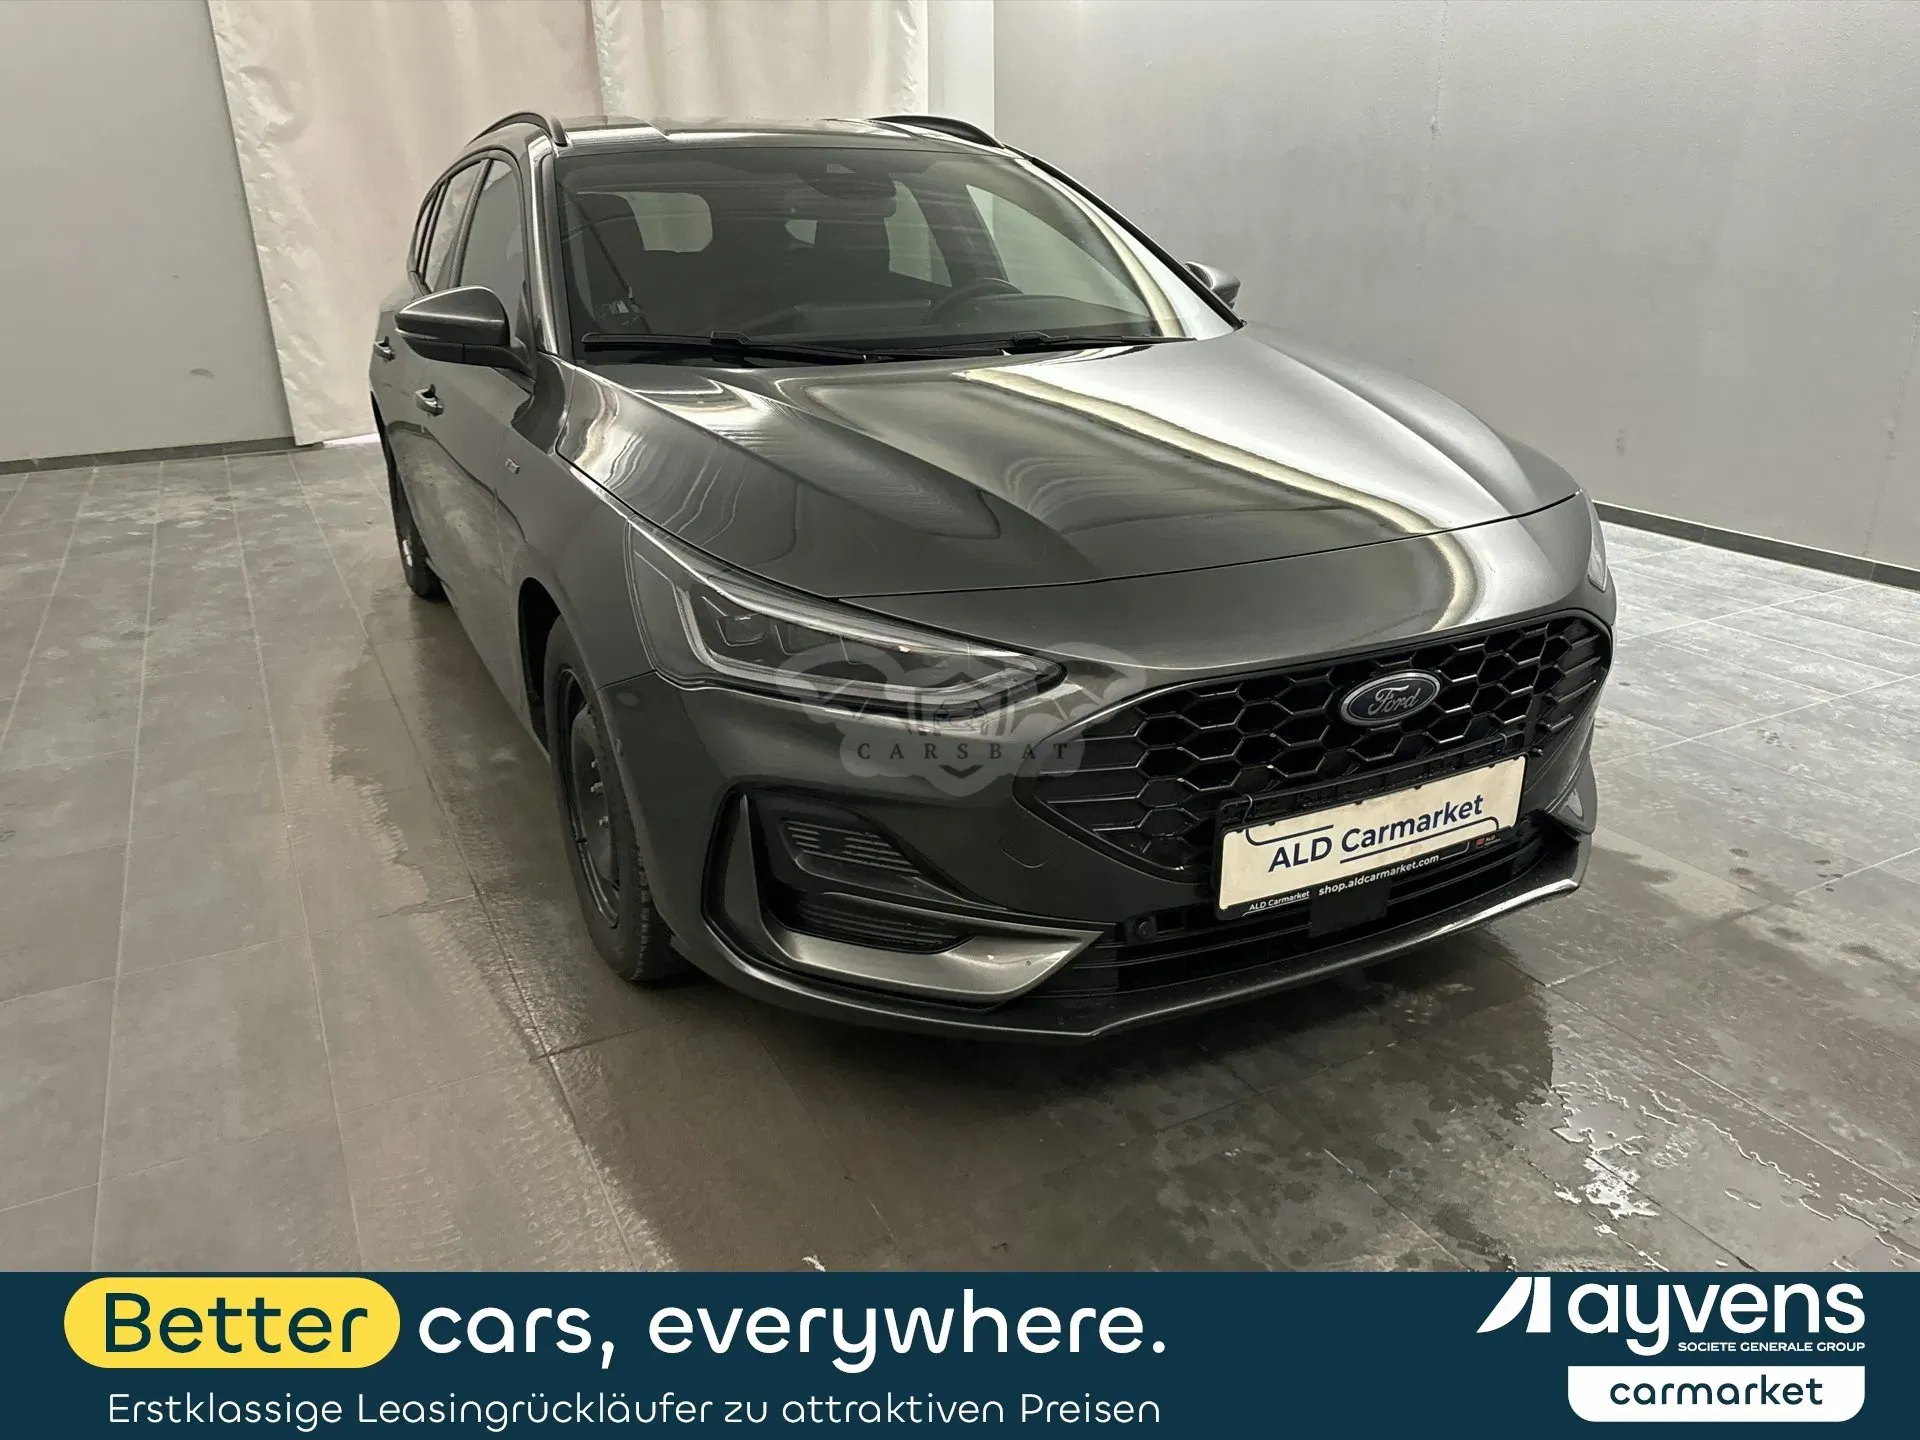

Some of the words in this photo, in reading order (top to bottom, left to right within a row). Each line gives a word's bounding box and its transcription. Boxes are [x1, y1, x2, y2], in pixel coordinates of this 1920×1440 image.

[1368, 684, 1421, 715] Ford
[1268, 836, 1332, 872] ALD
[1341, 795, 1484, 853] Carmarket
[1318, 854, 1440, 896] shop.aldcarmarket.com
[1249, 901, 1267, 911] ALD
[1268, 890, 1310, 907] Carmarket
